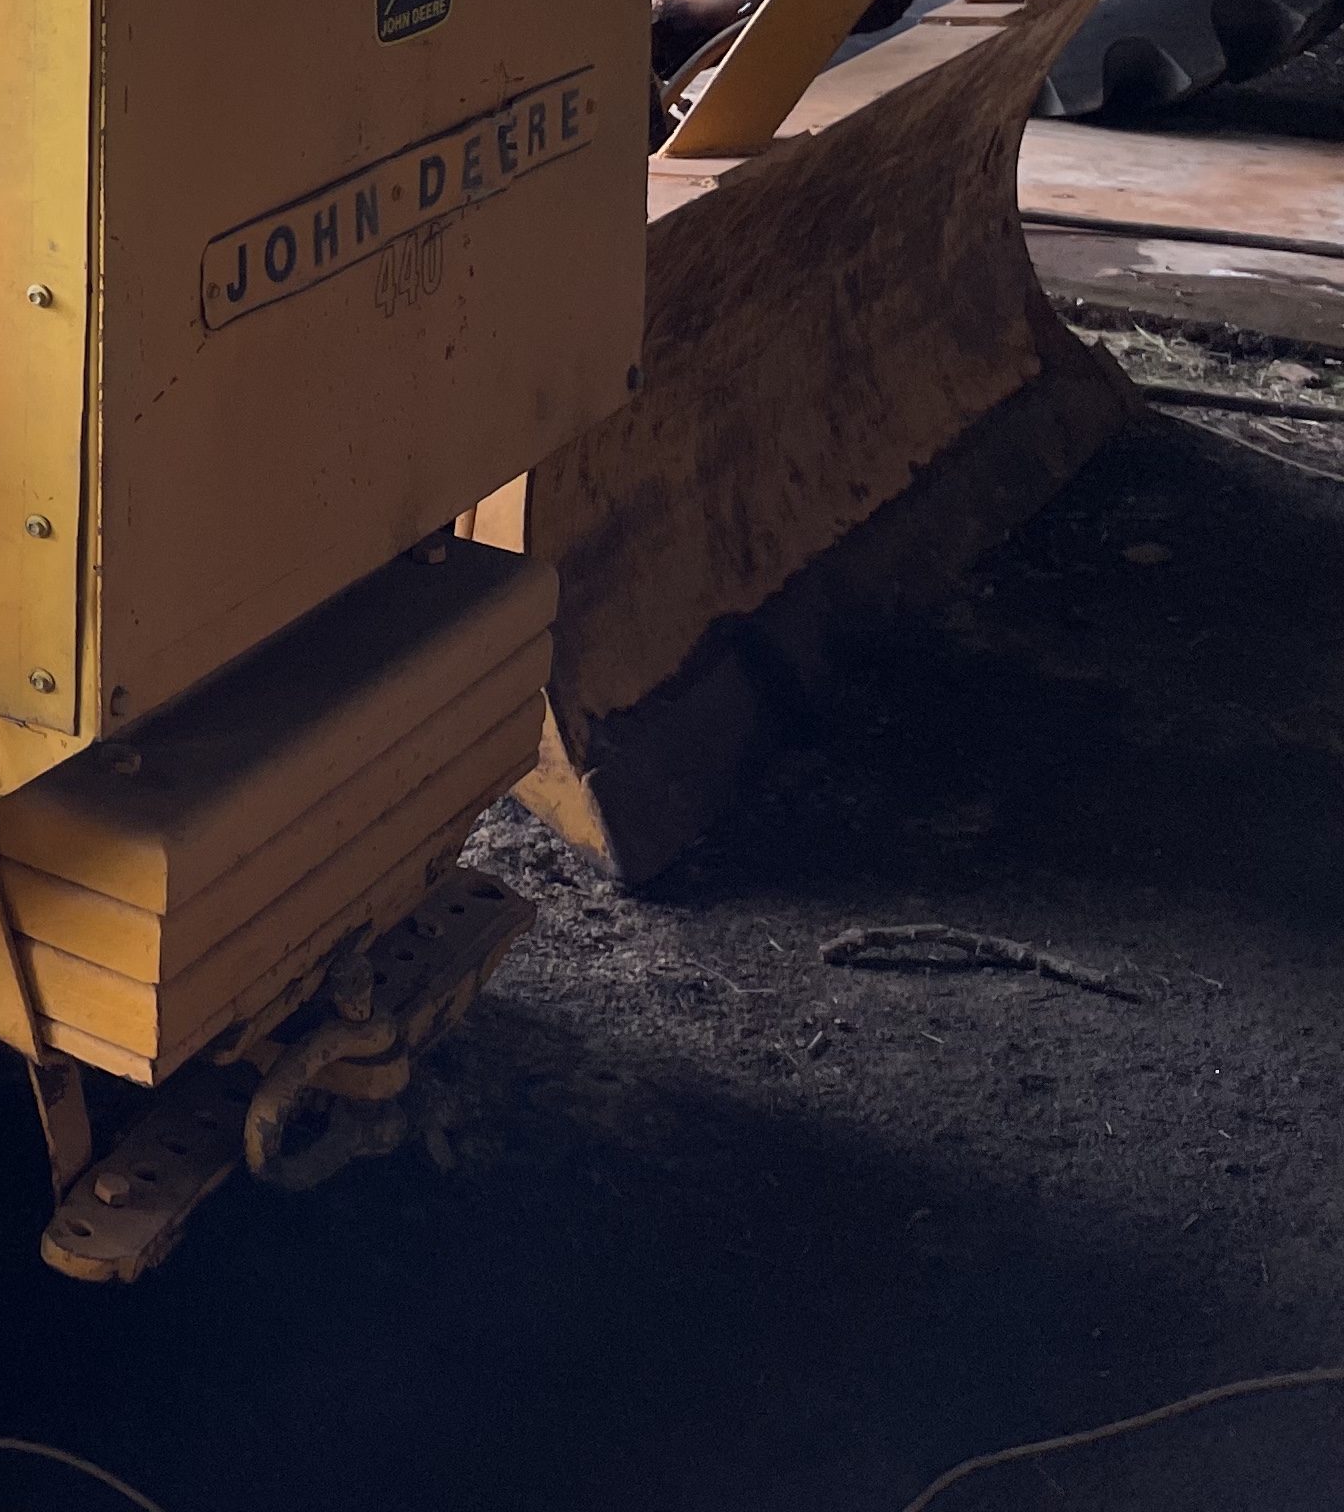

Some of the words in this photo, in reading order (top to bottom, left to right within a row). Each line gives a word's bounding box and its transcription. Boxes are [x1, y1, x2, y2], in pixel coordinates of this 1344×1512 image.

[380, 11, 411, 38] JOHN
[225, 182, 381, 304] JOHN
[418, 88, 581, 211] DEERE
